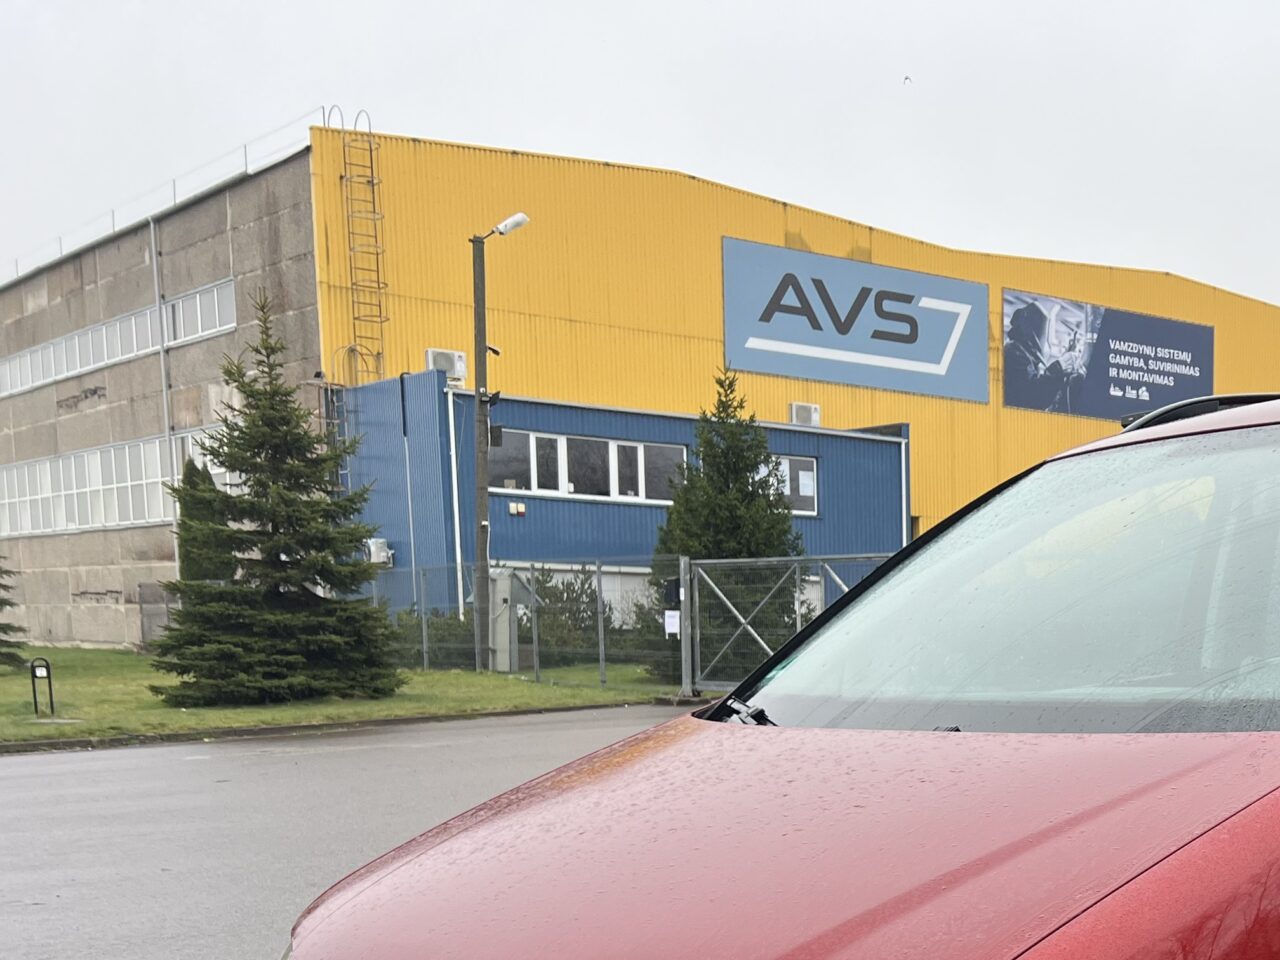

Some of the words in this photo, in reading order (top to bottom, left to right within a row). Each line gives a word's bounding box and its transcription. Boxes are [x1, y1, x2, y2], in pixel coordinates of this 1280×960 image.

[758, 272, 919, 344] AVS
[1109, 338, 1155, 358] VAMZDYNŲ
[1157, 347, 1192, 364] SISTEMŲ
[1109, 353, 1147, 370] GAMYBA,
[1148, 359, 1200, 377] SUVIRINIMAS
[1109, 367, 1118, 378] IR
[1119, 368, 1175, 387] MONTAVIMAS
